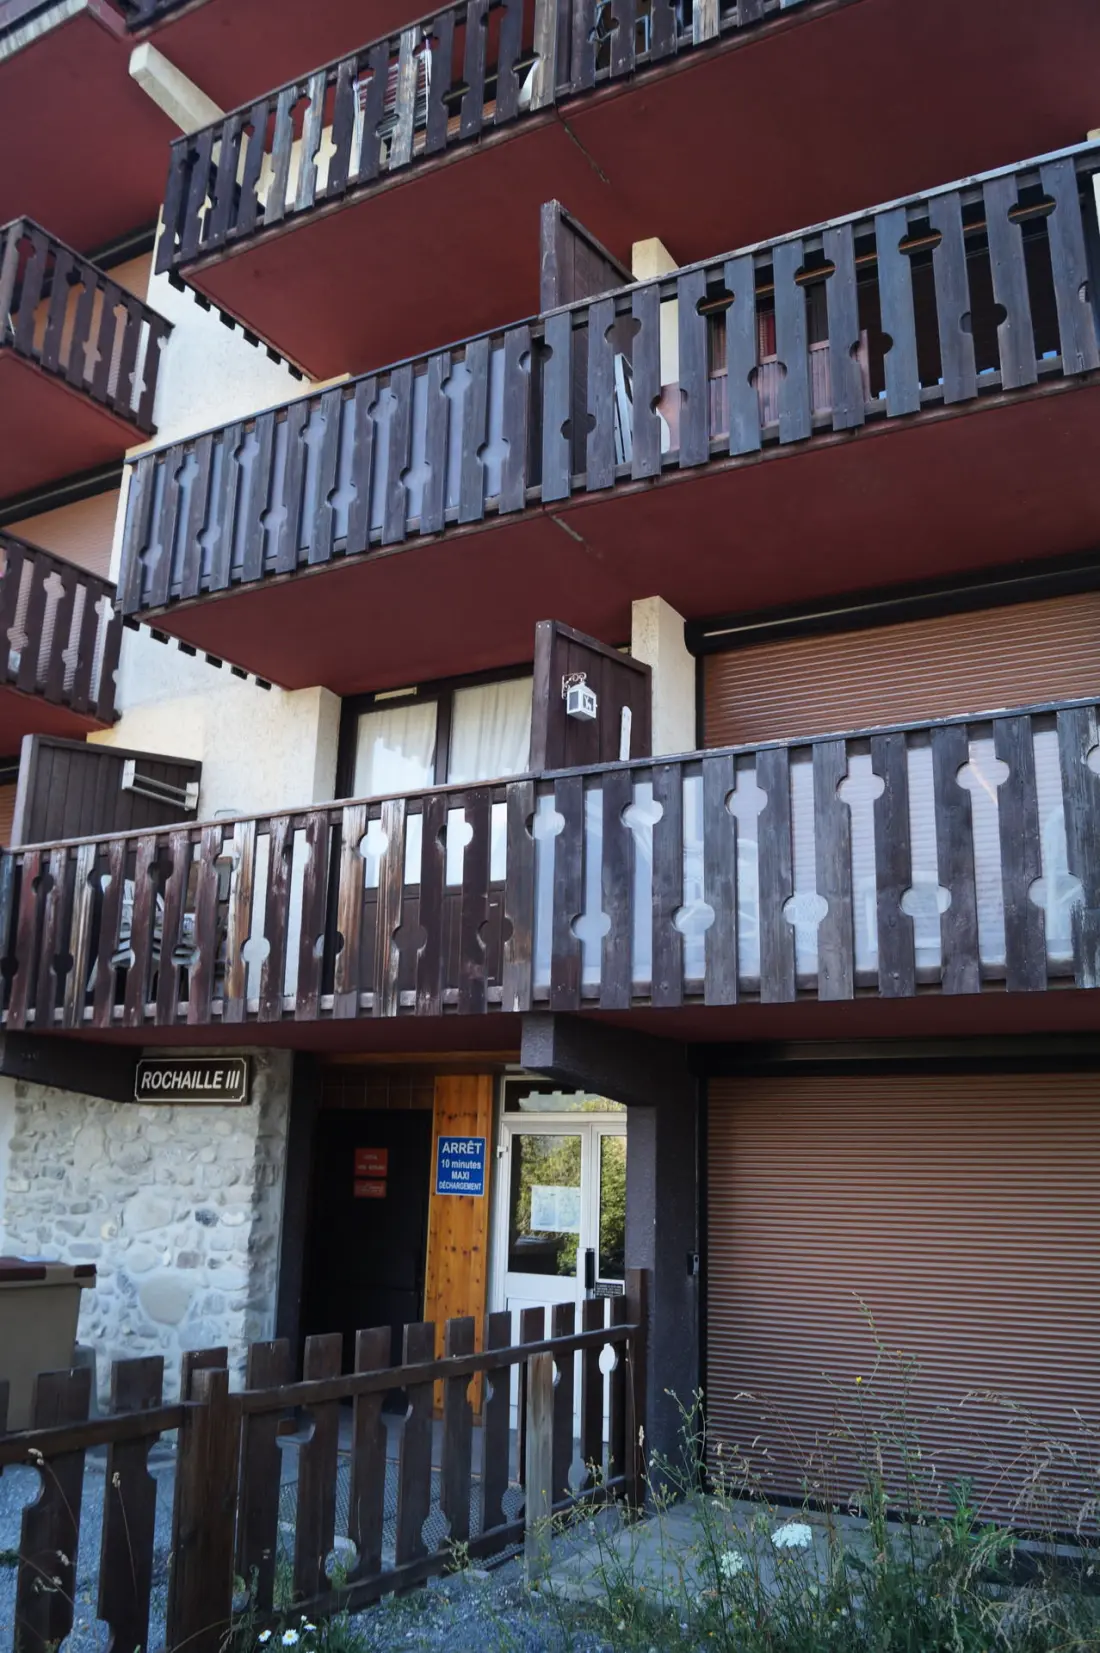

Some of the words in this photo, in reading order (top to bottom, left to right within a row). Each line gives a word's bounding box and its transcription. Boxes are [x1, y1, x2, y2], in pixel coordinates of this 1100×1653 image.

[141, 1070, 223, 1089] ROCHAILLE
[225, 1070, 240, 1089] III
[442, 1140, 482, 1154] ARRÊT
[441, 1159, 450, 1168] 10
[451, 1160, 481, 1169] minutes
[451, 1171, 470, 1180] MAXI
[439, 1180, 481, 1190] DÉCHARGEMENT
